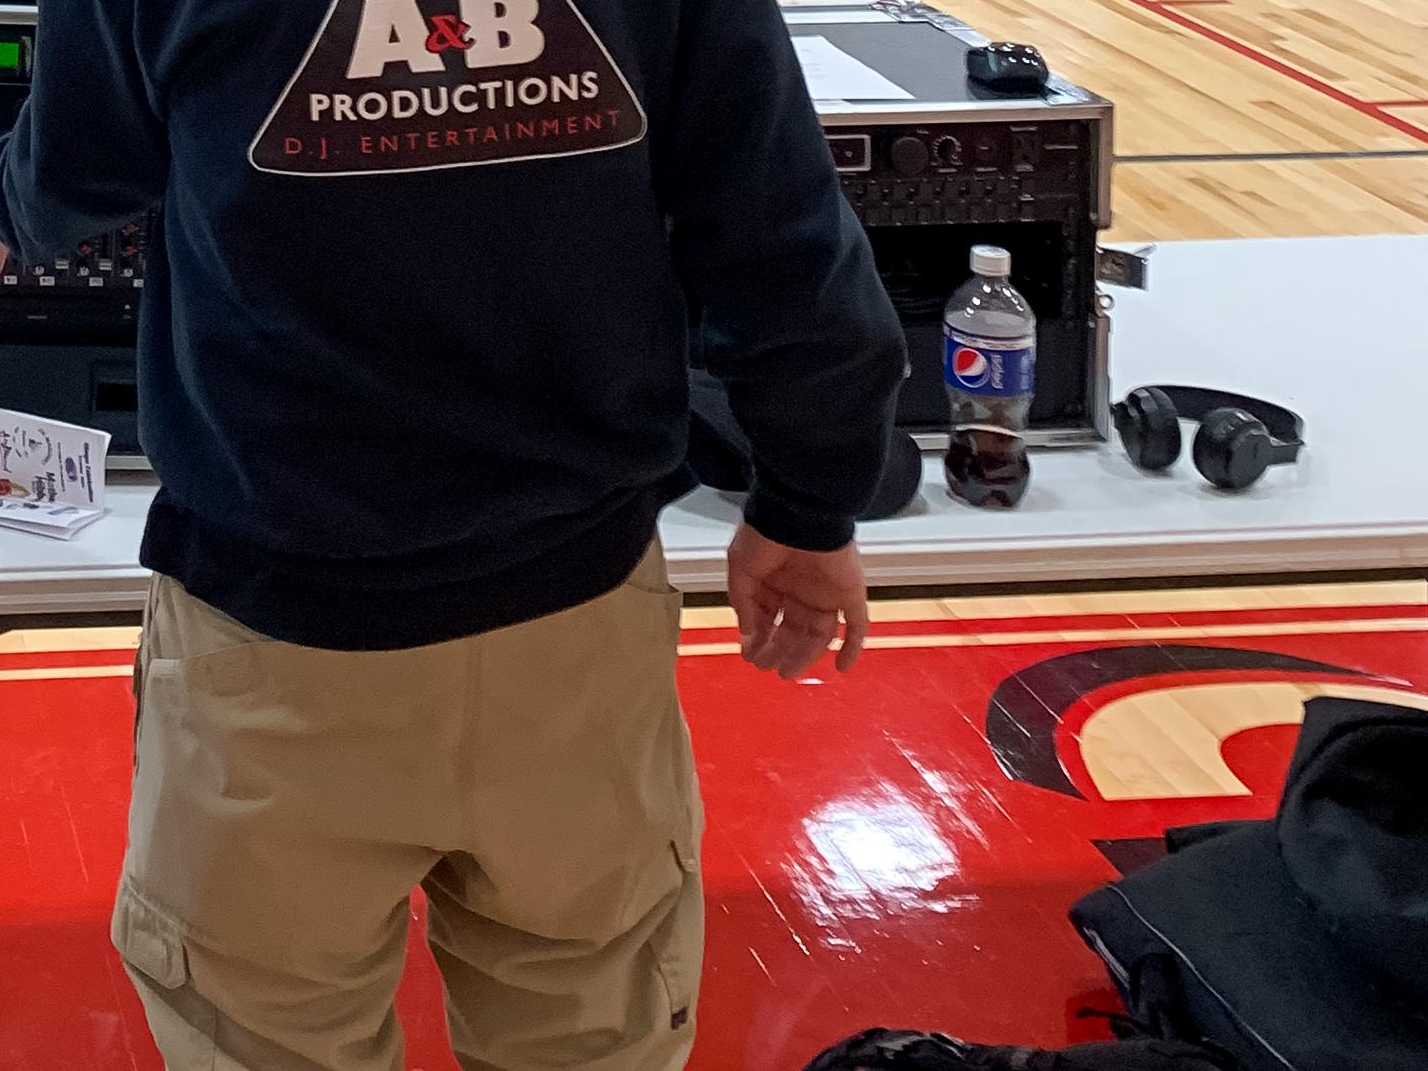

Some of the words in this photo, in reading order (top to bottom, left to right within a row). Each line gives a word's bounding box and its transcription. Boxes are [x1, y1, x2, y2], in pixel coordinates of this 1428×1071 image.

[309, 70, 600, 122] PRODUCTIONS
[283, 136, 341, 160] D.J.
[360, 110, 621, 155] ENTERTAINMENT
